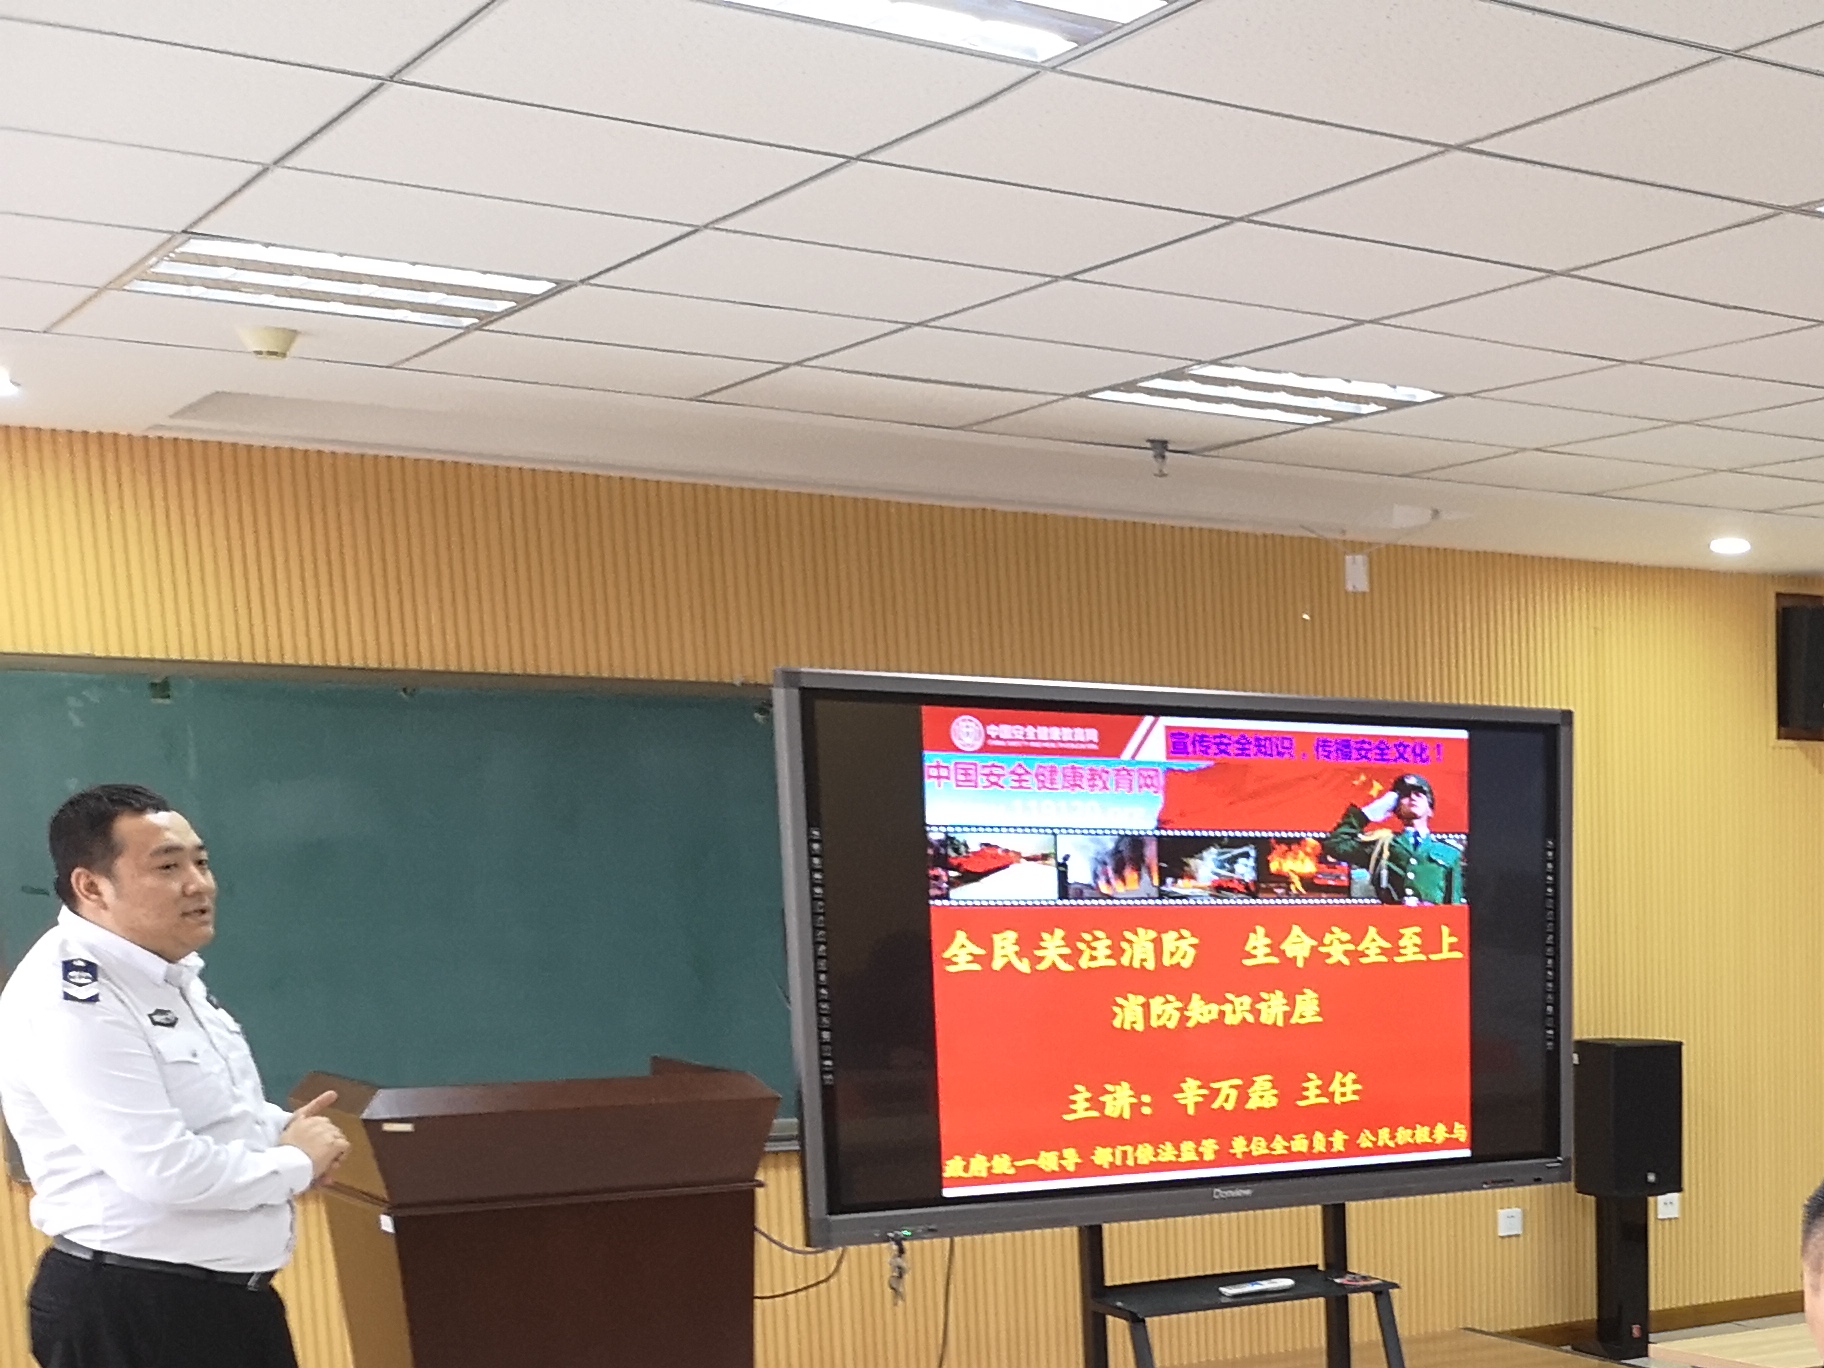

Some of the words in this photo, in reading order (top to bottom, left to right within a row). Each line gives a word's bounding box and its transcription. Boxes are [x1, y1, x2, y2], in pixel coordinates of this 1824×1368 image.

[925, 759, 1163, 795] 中国安全健康教育网
[941, 926, 1200, 974] 全民关注消防
[1241, 924, 1465, 969] 生命安全至上
[1111, 988, 1324, 1032] 消防知识讲座
[1295, 1070, 1364, 1107] 主任
[942, 1147, 1083, 1179] 政府统一领导
[1090, 1138, 1220, 1170] 部门依法监管
[1228, 1128, 1350, 1159] 单位全面负责
[1355, 1120, 1469, 1149] 公民积极参与
